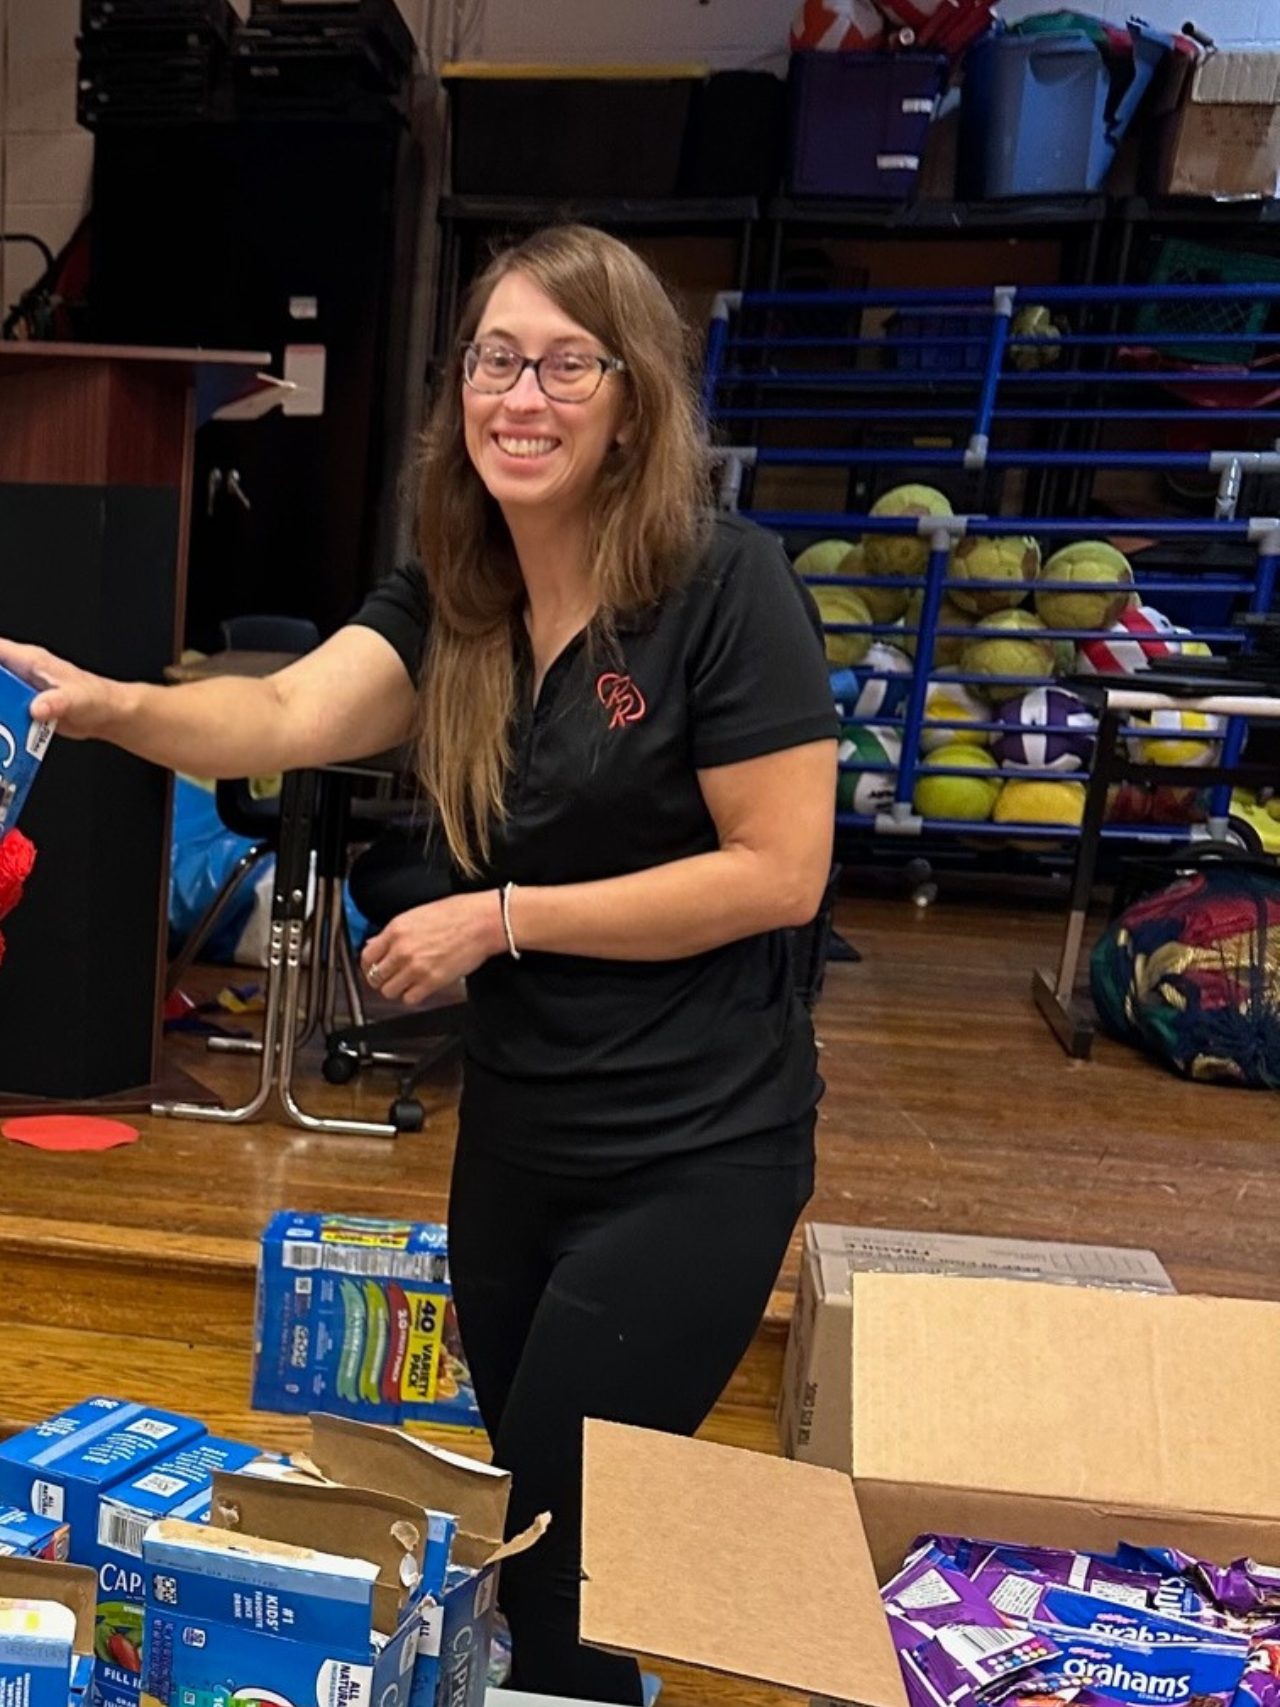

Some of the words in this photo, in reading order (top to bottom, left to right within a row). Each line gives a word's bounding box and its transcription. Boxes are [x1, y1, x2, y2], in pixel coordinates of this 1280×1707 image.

[420, 1300, 437, 1333] 40
[407, 1353, 421, 1390] PACK
[418, 1342, 434, 1397] VARIETY
[283, 1607, 296, 1625] #1
[104, 1667, 130, 1686] FILL
[337, 1664, 351, 1707] NATURA
[349, 1680, 361, 1701] ALL
[1062, 1658, 1192, 1698] grahams
